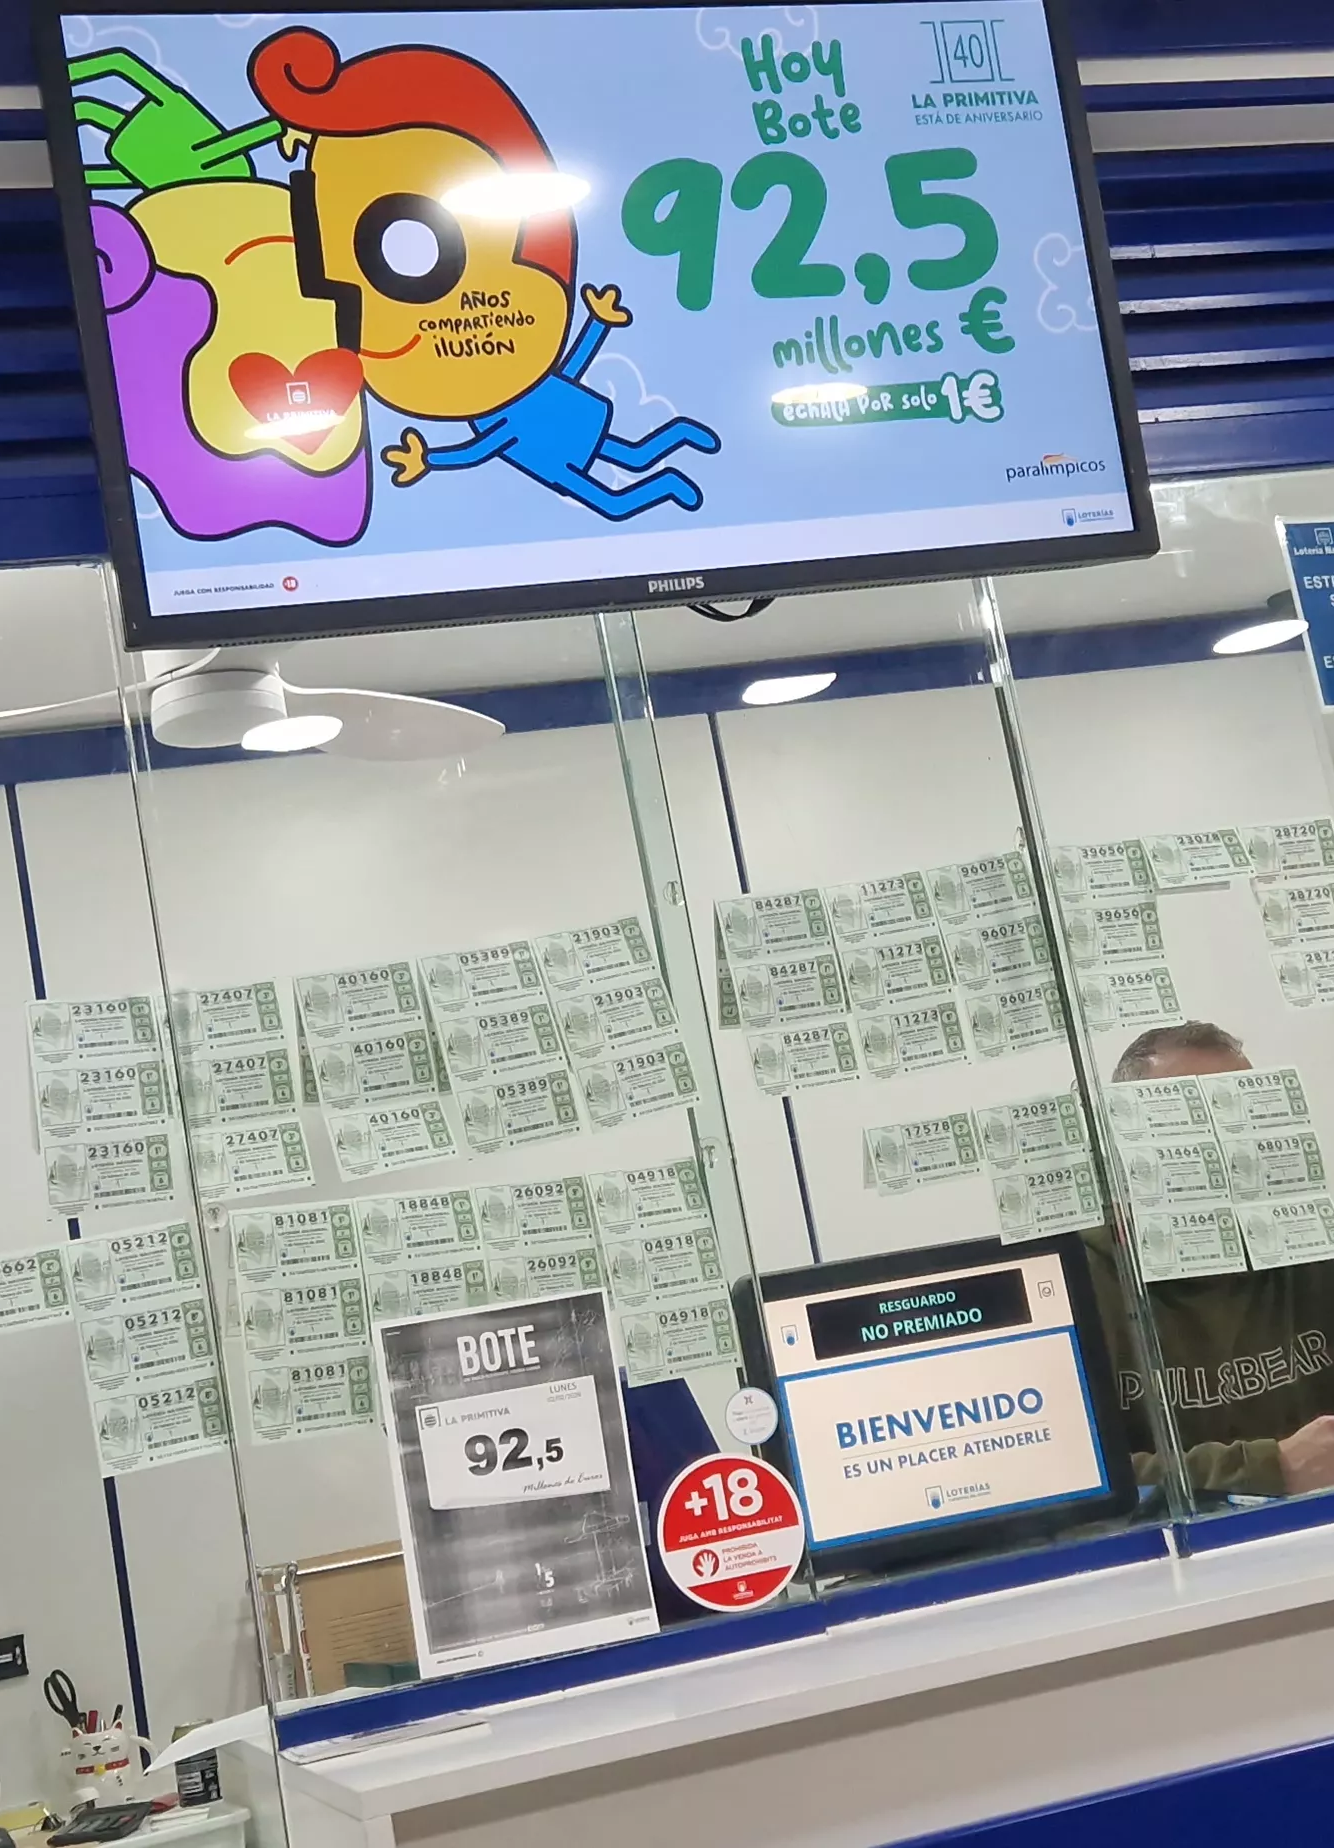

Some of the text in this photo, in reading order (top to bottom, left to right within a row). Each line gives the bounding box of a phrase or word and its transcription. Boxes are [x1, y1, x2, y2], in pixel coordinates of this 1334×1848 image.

[952, 35, 983, 68] 40
[741, 34, 845, 98] Hoy
[911, 90, 1039, 109] LA PRIMITIVA
[751, 94, 863, 146] Bote
[915, 109, 1044, 126] ESTÁ DE ANIVERSARIO
[621, 147, 999, 312] 92,5
[959, 287, 1015, 354] €
[214, 583, 275, 593] RESPONSABILIDAD
[648, 577, 705, 594] PHILIPS
[1274, 825, 1316, 838] 28720
[1082, 845, 1124, 858] 39656
[961, 858, 1005, 876] 96075
[861, 878, 904, 894] 11273
[1289, 887, 1330, 900] 28720
[755, 895, 800, 911] 84287
[1095, 908, 1139, 921] 39656
[572, 925, 621, 943] 21903
[981, 922, 1025, 940] 96075
[460, 947, 510, 965] 05389
[878, 943, 922, 960] 11273
[770, 961, 815, 977] 84287
[337, 969, 389, 988] 40160
[1108, 972, 1153, 985] 39656
[200, 988, 253, 1005] 27407
[594, 986, 644, 1007] 21903
[999, 988, 1042, 1007] 96075
[72, 1001, 128, 1016] 23160
[894, 1009, 938, 1026] 11273
[479, 1011, 529, 1029] 05389
[783, 1029, 829, 1044] 84287
[353, 1037, 405, 1056] 40160
[212, 1056, 266, 1074] 27407
[616, 1052, 666, 1073] 21903
[80, 1067, 136, 1083] 23160
[1237, 1074, 1281, 1089] 68019
[496, 1078, 548, 1098] 05389
[369, 1108, 420, 1125] 40160
[1012, 1102, 1057, 1119] 22092
[225, 1128, 279, 1146] 27407
[904, 1120, 950, 1137] 17578
[88, 1142, 145, 1159] 23160
[1257, 1137, 1300, 1152] 68019
[627, 1167, 676, 1184] 04918
[1028, 1170, 1072, 1187] 22092
[514, 1183, 564, 1199] 26092
[398, 1196, 450, 1212] 18848
[1272, 1203, 1315, 1218] 68019
[275, 1211, 329, 1227] 81081
[111, 1232, 167, 1253] 05212
[645, 1235, 694, 1253] 04918
[527, 1254, 577, 1271] 26092
[410, 1267, 463, 1285] 18848
[284, 1286, 338, 1303] 81081
[879, 1291, 956, 1315] RESGUARDO
[124, 1309, 181, 1331] 05212
[659, 1307, 709, 1326] 04918
[860, 1307, 983, 1343] NO PREMIADO
[456, 1324, 541, 1378] BOTE
[291, 1364, 346, 1382] 81081
[549, 1382, 578, 1394] LUNES
[138, 1387, 196, 1410] 05212
[445, 1407, 511, 1426] LA PRIMITIVA
[835, 1387, 1044, 1450] BIENVENIDO
[464, 1428, 564, 1477] 92,5
[843, 1428, 1052, 1480] ES UN PLACER ATENDERLE
[685, 1468, 763, 1521] +18
[946, 1482, 991, 1499] LOTERÍAS
[679, 1515, 783, 1543] JUGA AMB RESPONSABILITAT
[723, 1555, 733, 1563] LA
